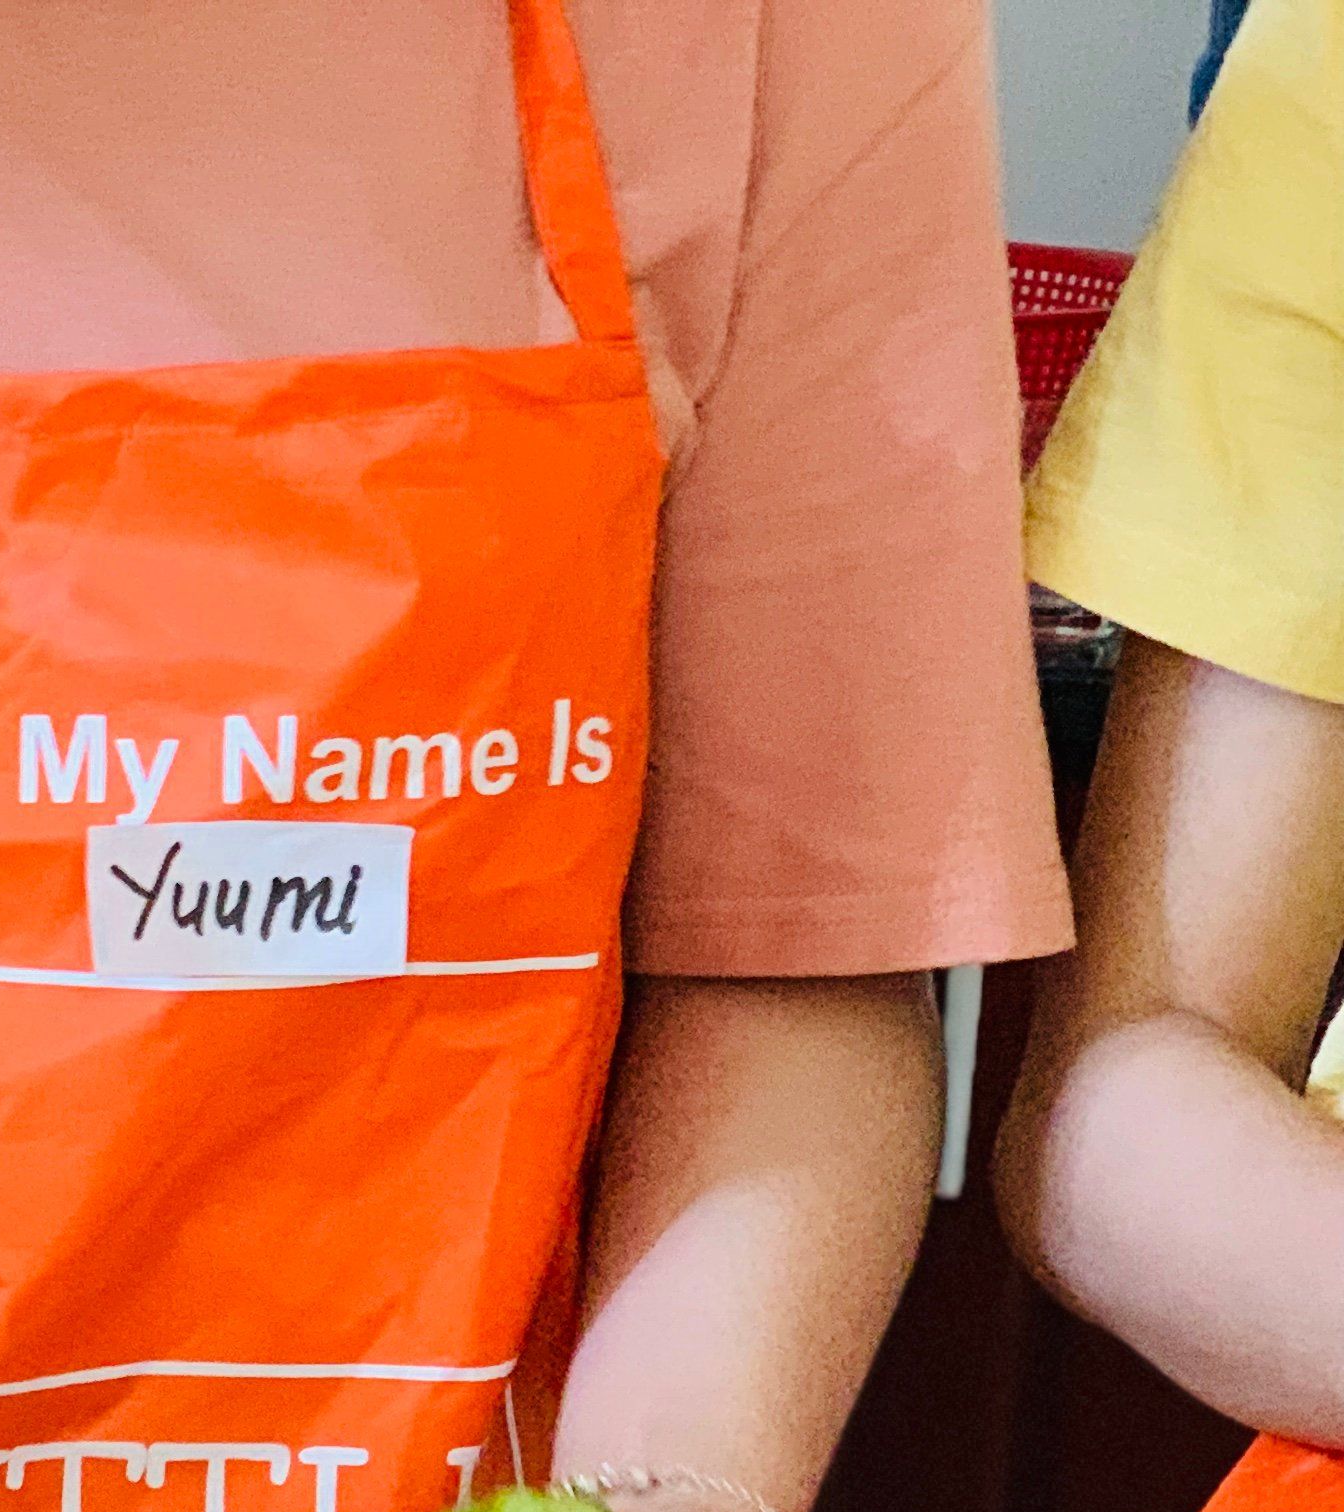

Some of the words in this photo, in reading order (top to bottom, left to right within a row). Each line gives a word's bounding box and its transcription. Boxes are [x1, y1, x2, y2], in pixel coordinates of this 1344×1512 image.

[18, 713, 180, 826] My
[221, 713, 519, 804] Name
[548, 699, 613, 785] Is
[110, 841, 364, 941] Yuumi
